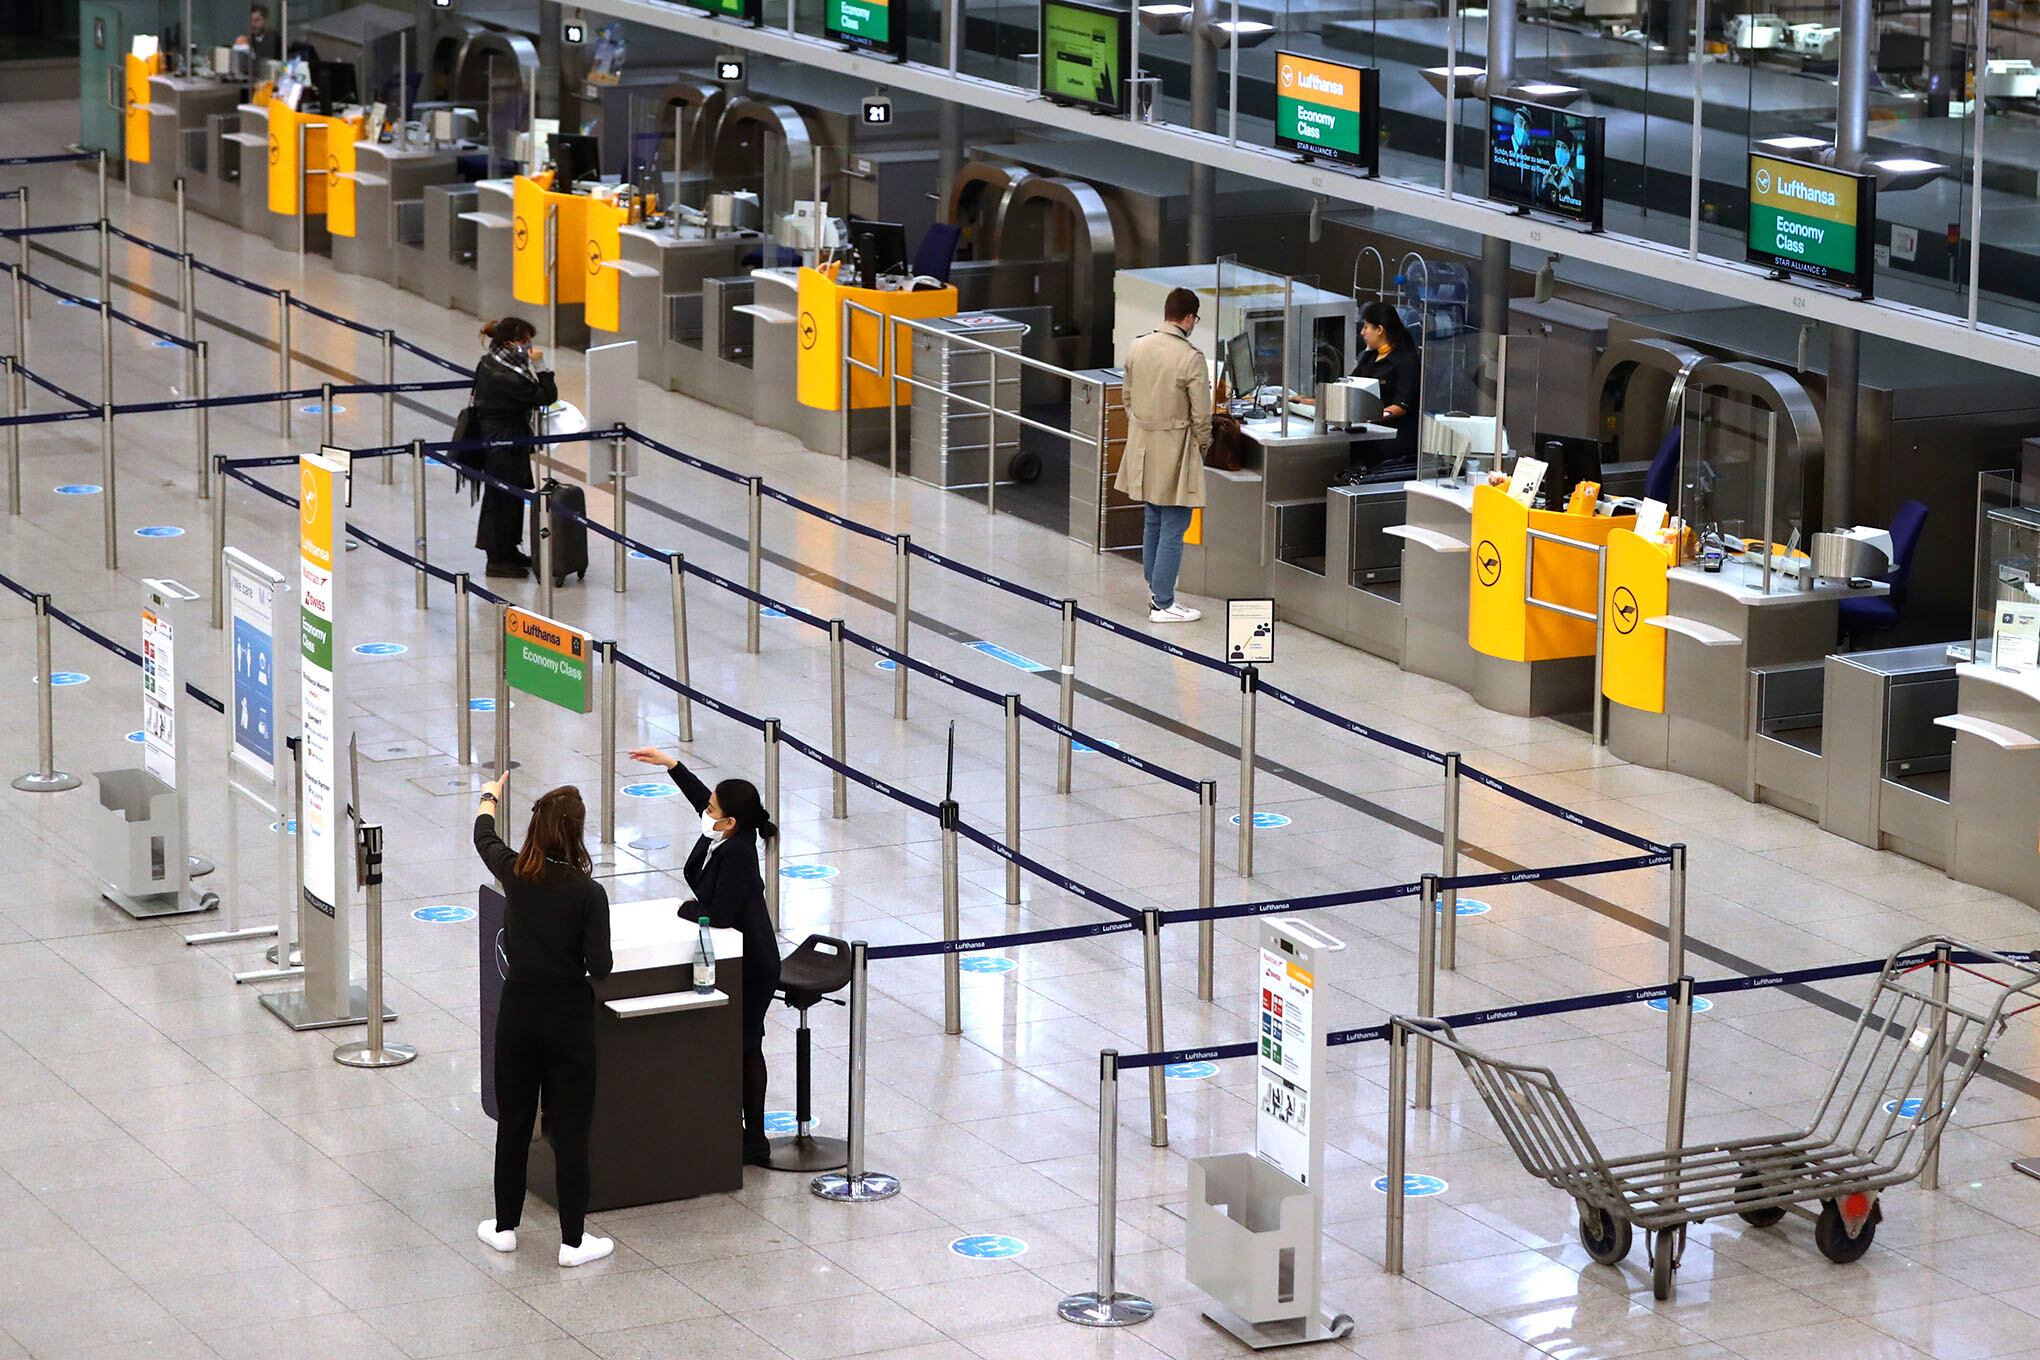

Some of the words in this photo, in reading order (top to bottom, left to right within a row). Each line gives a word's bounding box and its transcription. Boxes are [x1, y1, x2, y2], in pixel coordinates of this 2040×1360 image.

[1298, 71, 1344, 96] Lufthansa
[870, 106, 885, 122] 21
[1298, 105, 1336, 129] Economy
[1298, 121, 1320, 139] Class
[1777, 176, 1835, 206] Lufthansa
[1558, 194, 1582, 206] Lufthansa
[1776, 216, 1824, 244] Economy
[1776, 234, 1804, 254] Class
[1775, 256, 1790, 268] STAR
[1790, 260, 1820, 275] ALLIANCE
[1792, 296, 1806, 308] 424
[302, 616, 327, 644] Economy
[523, 621, 560, 646] Lufthansa
[302, 633, 315, 653] Class
[522, 646, 558, 673] Economy
[560, 660, 582, 680] Class
[1260, 902, 1289, 912] Lufthansa
[1102, 922, 1132, 932] Lufthansa
[955, 941, 985, 950] Lufthansa
[1754, 976, 1783, 986] Lufthansa
[1636, 987, 1666, 999] Lufthansa
[1486, 1010, 1518, 1021] Lufthansa
[1346, 1030, 1378, 1041] Lufthansa
[1185, 1050, 1218, 1061] Lufthansa
